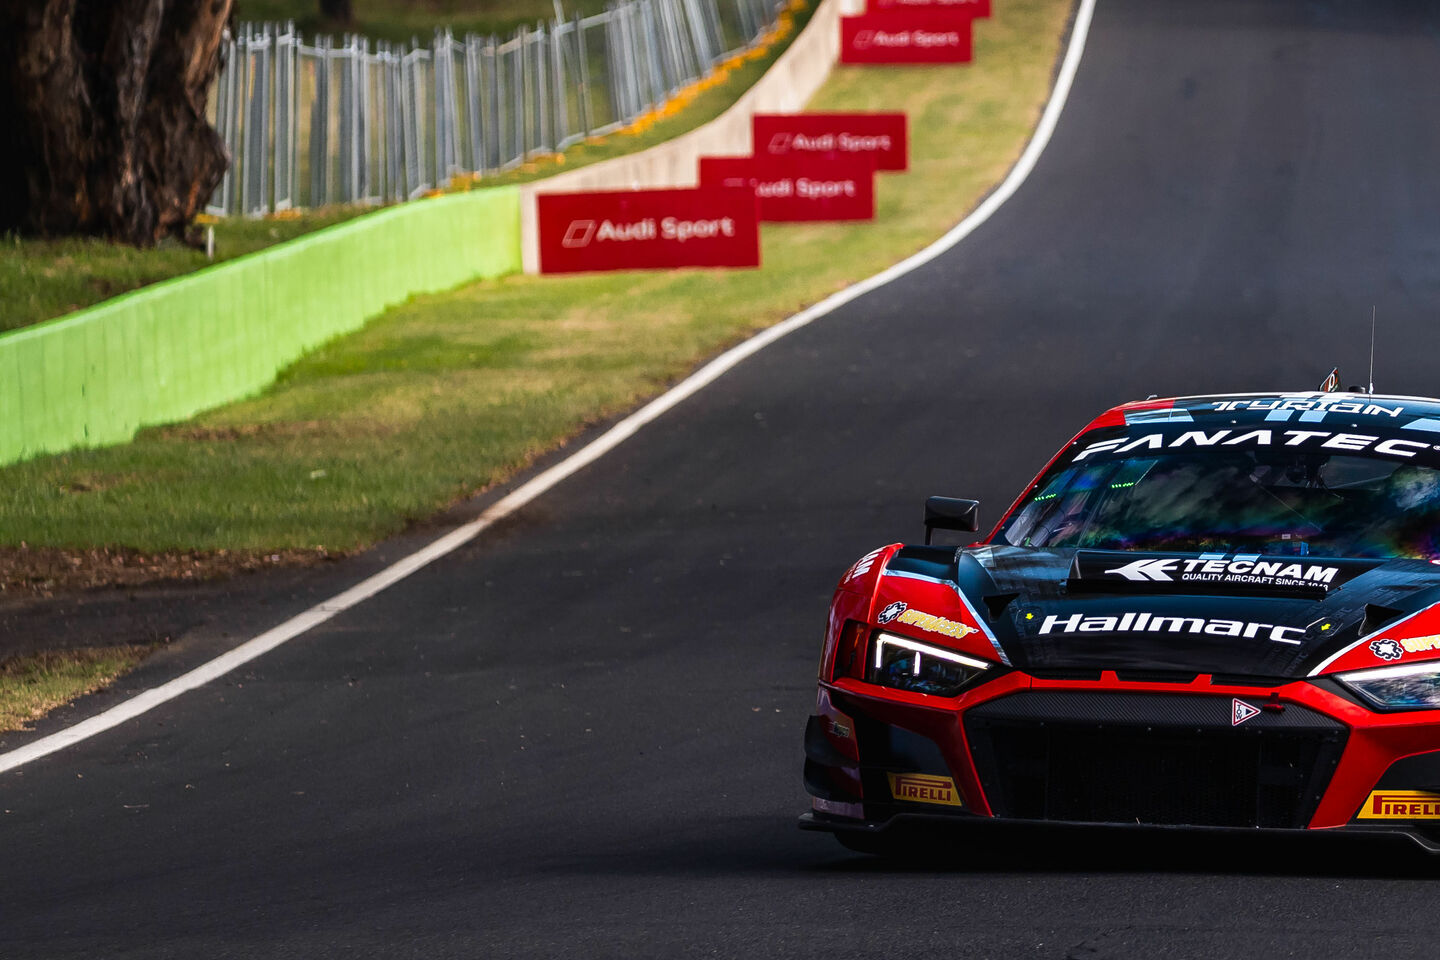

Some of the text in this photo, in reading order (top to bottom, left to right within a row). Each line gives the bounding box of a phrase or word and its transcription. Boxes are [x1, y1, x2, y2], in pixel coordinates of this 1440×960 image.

[873, 29, 960, 49] Audi Sport
[792, 131, 891, 153] Audi Sport
[750, 177, 856, 200] udi Sport
[596, 216, 735, 243] Audi Sport
[1072, 429, 1432, 463] FANATEC
[1182, 573, 1224, 582] QUALITY
[1224, 574, 1274, 585] AIRCRAFT
[1275, 577, 1306, 587] SINCE
[1183, 558, 1339, 583] TECNAM
[1038, 612, 1307, 645] Hallmarc
[895, 776, 953, 802] PIRELLI
